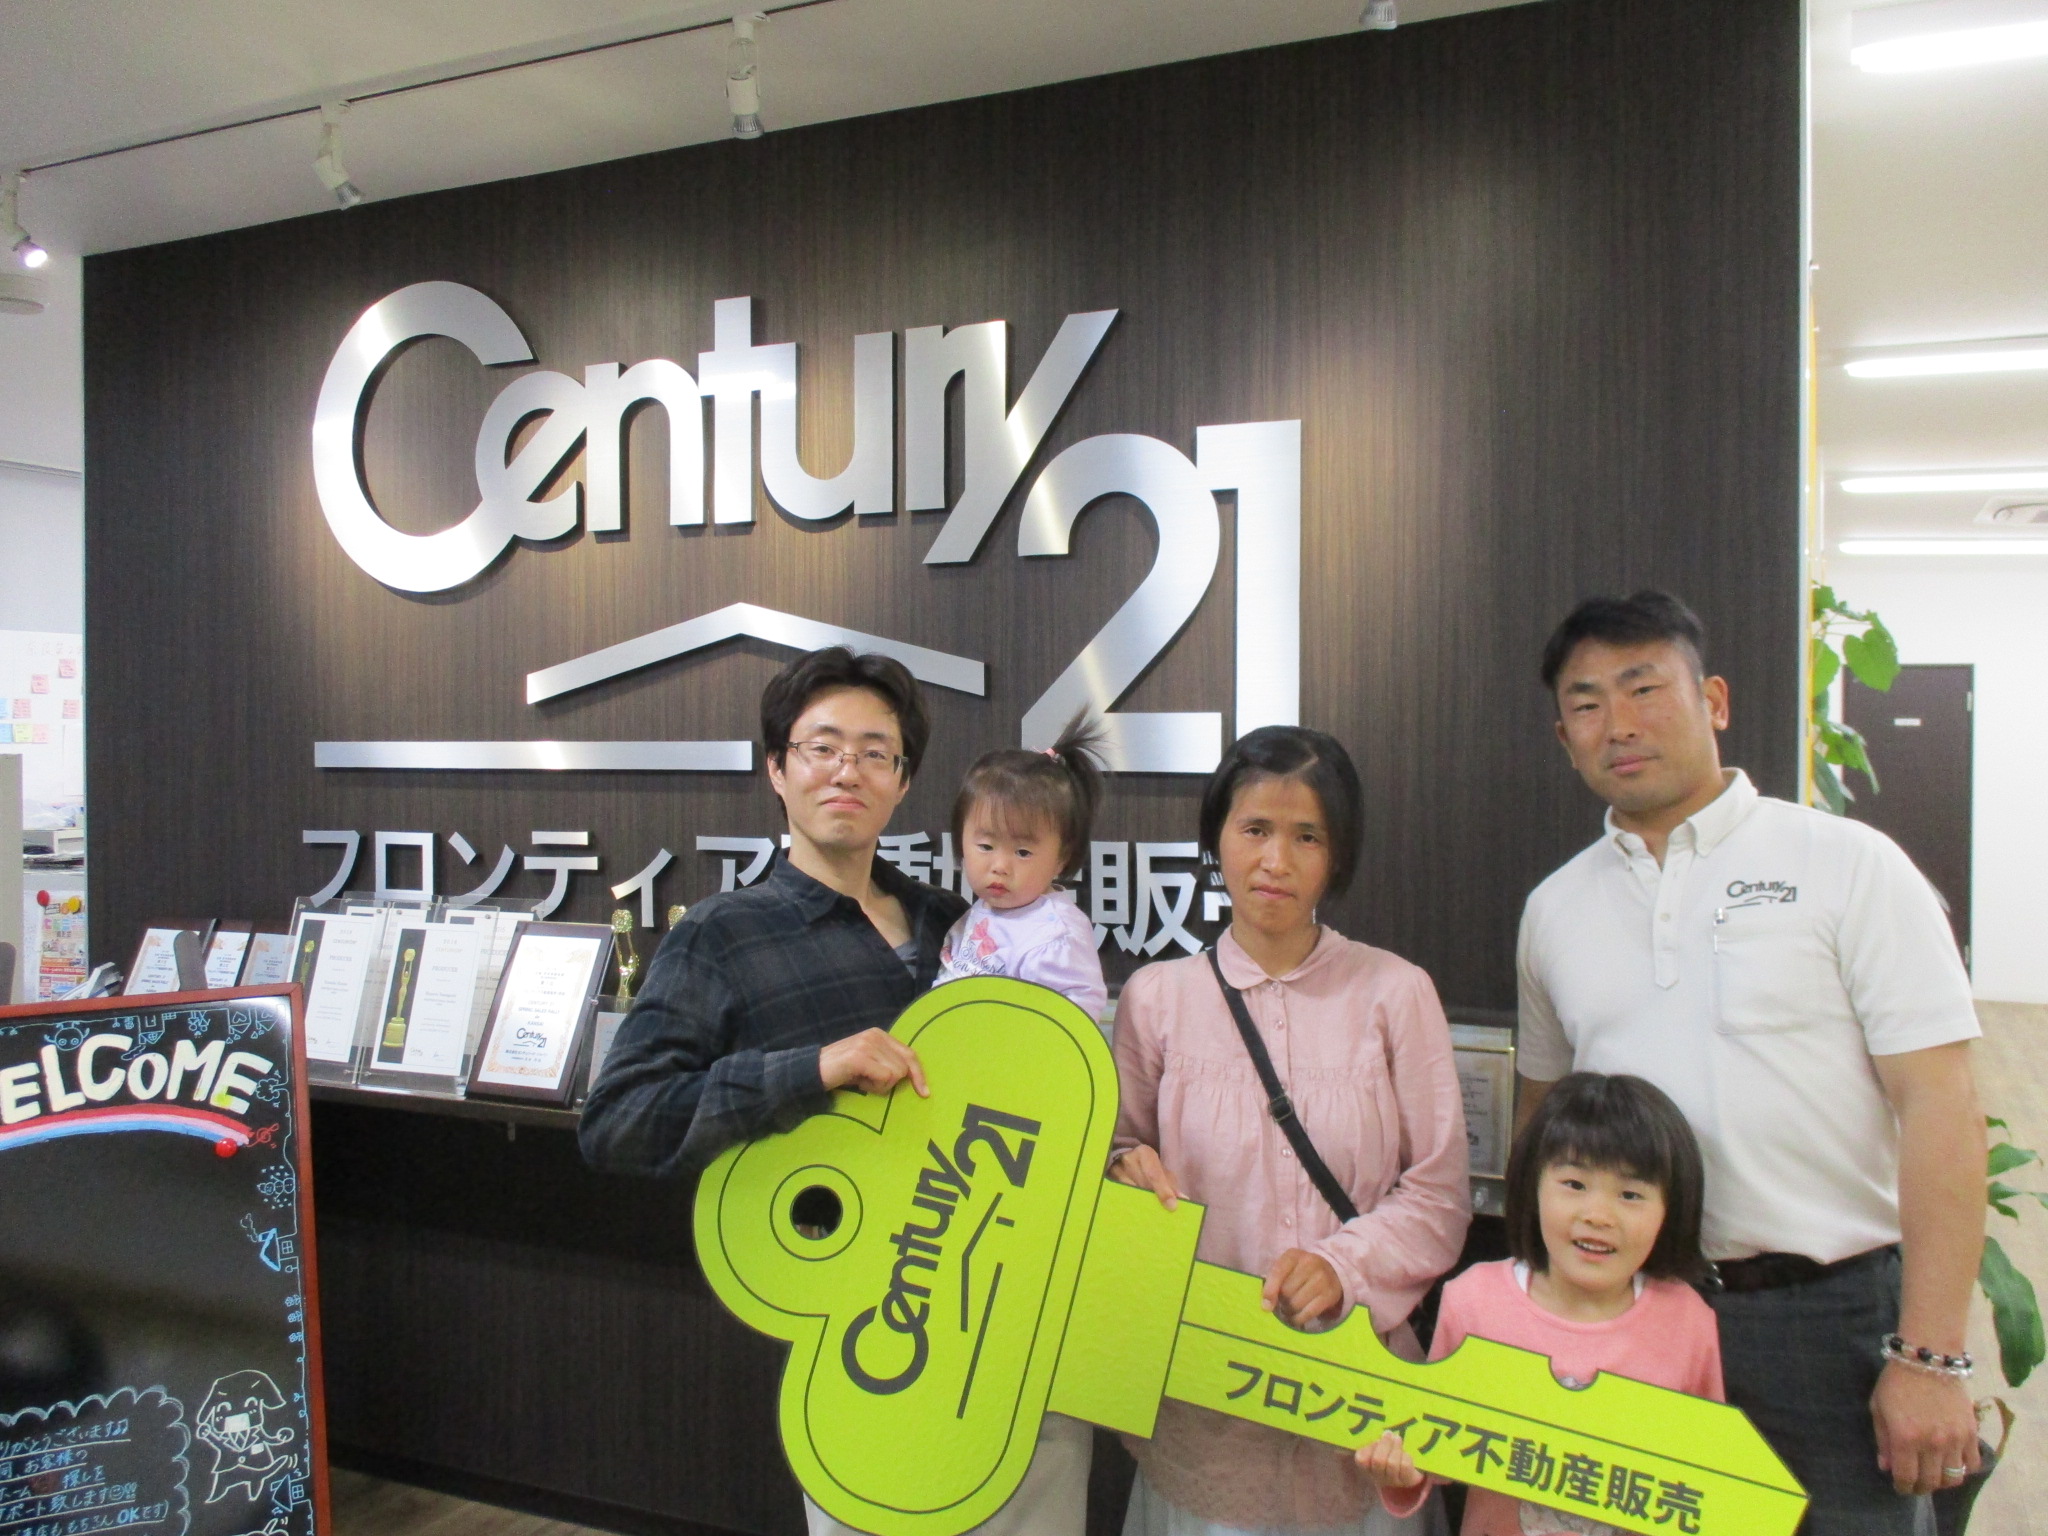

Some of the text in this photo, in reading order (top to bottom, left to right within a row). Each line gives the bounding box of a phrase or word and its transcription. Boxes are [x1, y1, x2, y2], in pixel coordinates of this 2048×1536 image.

[312, 281, 1302, 772] Century 21
[1726, 880, 1797, 903] Century 21
[840, 1102, 1042, 1396] Century 21
[1225, 1360, 1705, 1535] フロンティア不動産販売
